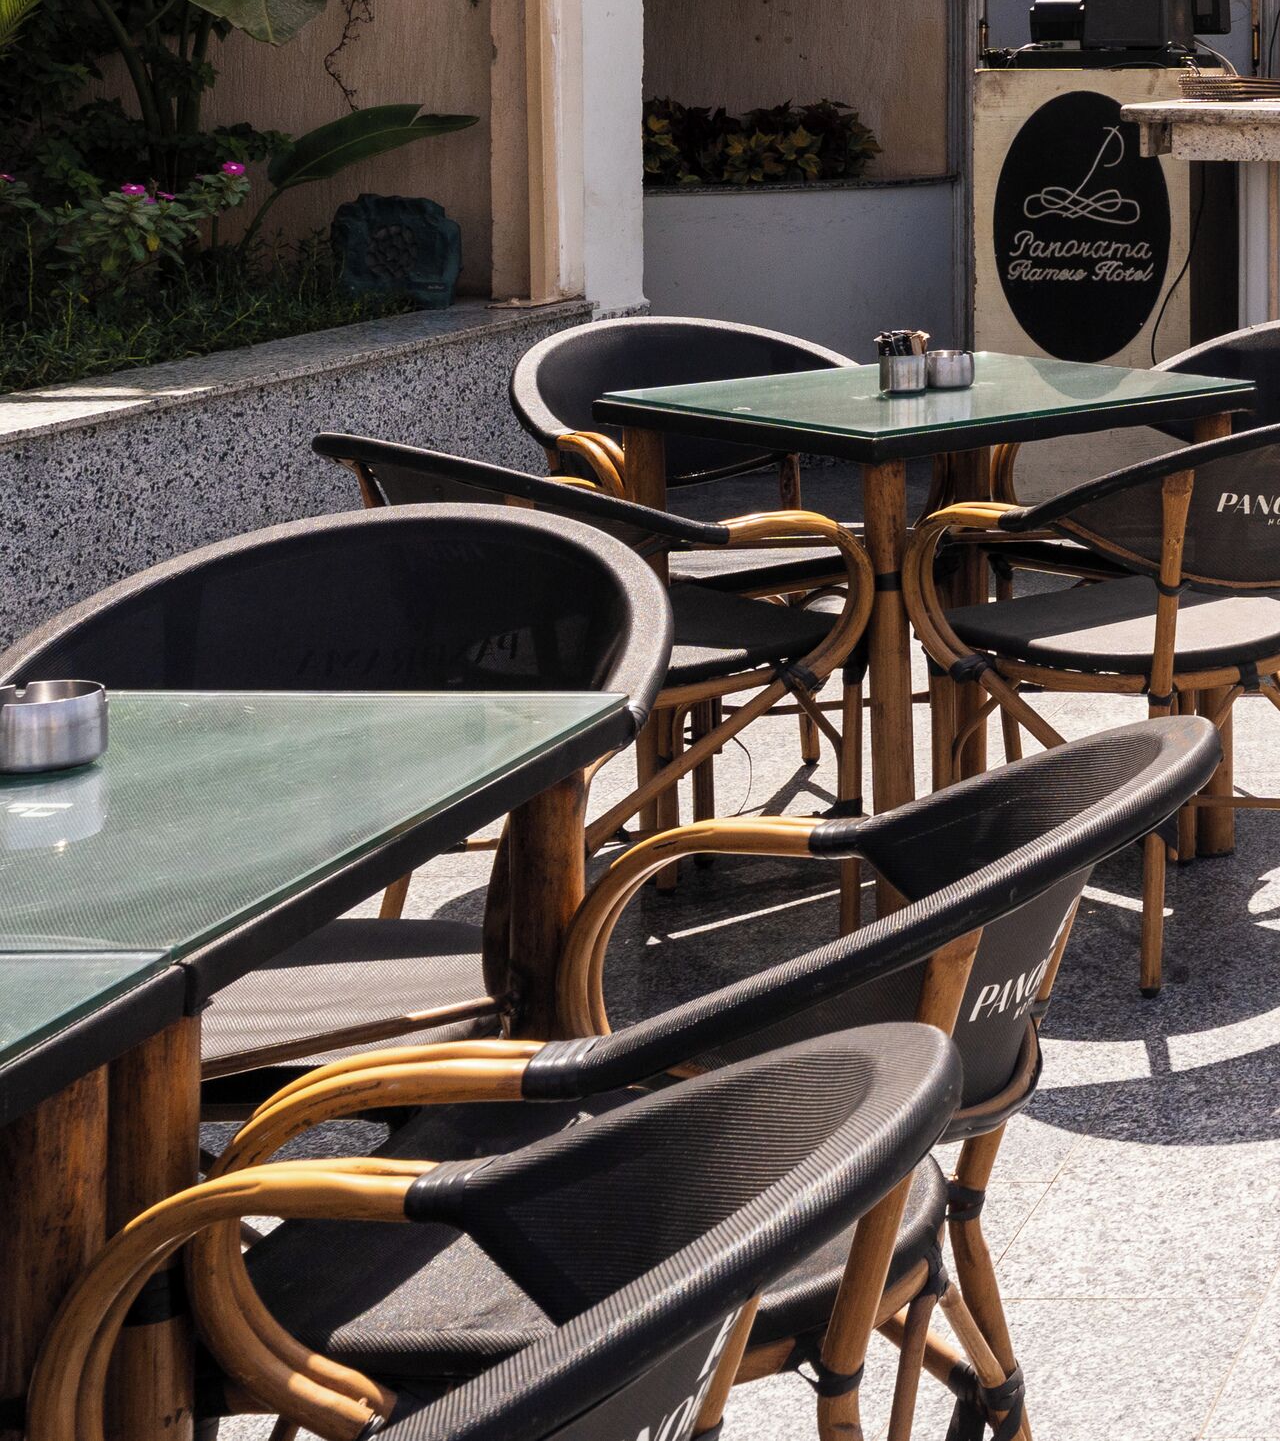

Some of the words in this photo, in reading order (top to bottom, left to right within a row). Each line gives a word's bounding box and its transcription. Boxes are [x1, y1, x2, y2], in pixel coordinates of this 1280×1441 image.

[1009, 230, 1153, 259] Panorama
[1092, 261, 1154, 282] Hotel
[968, 957, 1049, 1023] PANO
